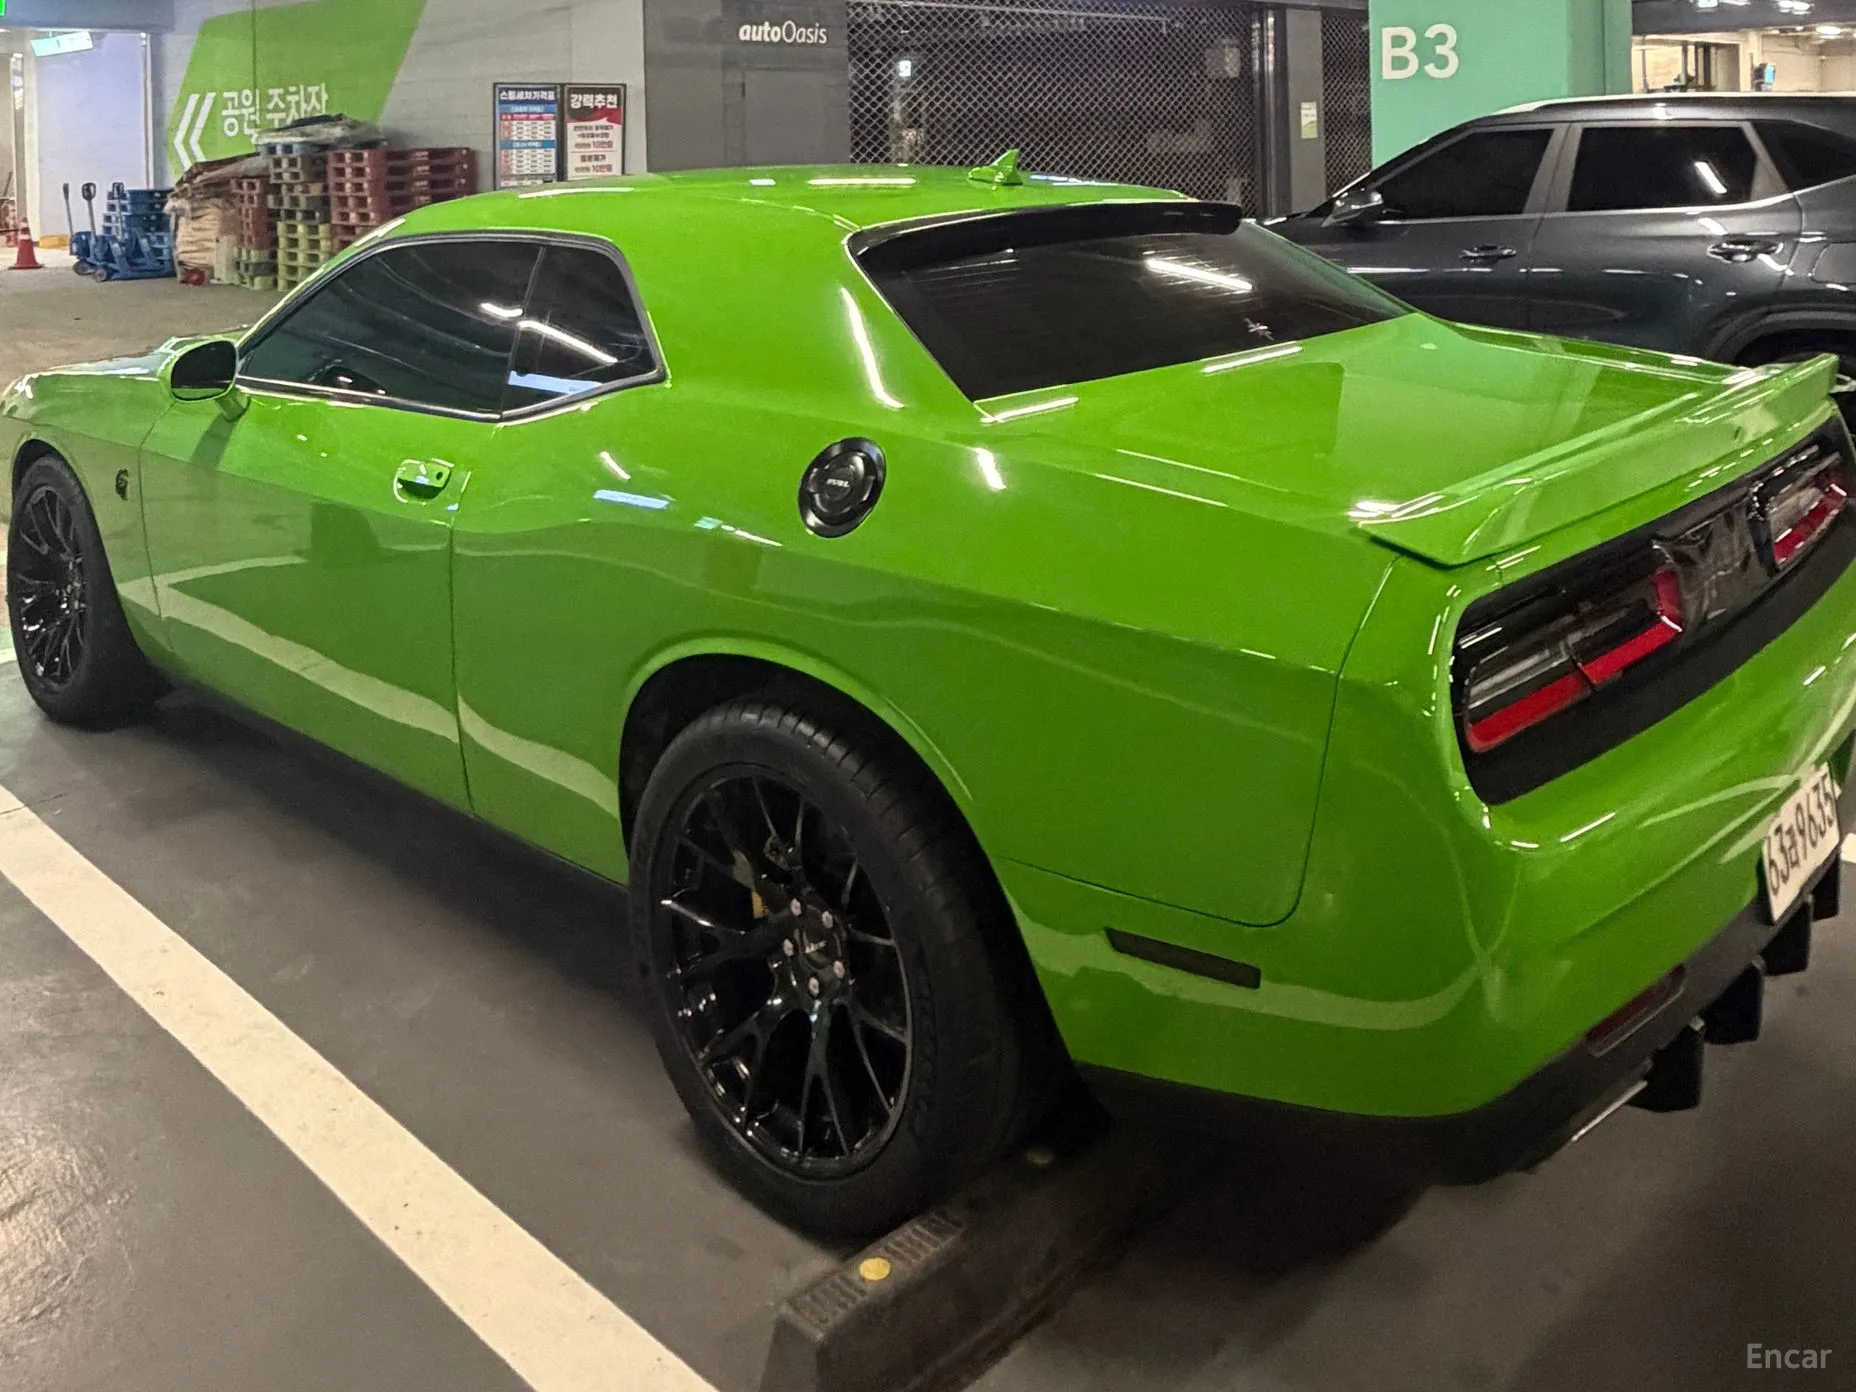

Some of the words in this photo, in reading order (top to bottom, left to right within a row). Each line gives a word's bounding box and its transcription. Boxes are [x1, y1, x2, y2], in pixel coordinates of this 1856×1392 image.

[738, 20, 828, 44] autoOasis
[1381, 23, 1460, 80] B3
[221, 88, 260, 137] 공원
[569, 93, 618, 109] 강력추천
[825, 478, 851, 488] FUEL
